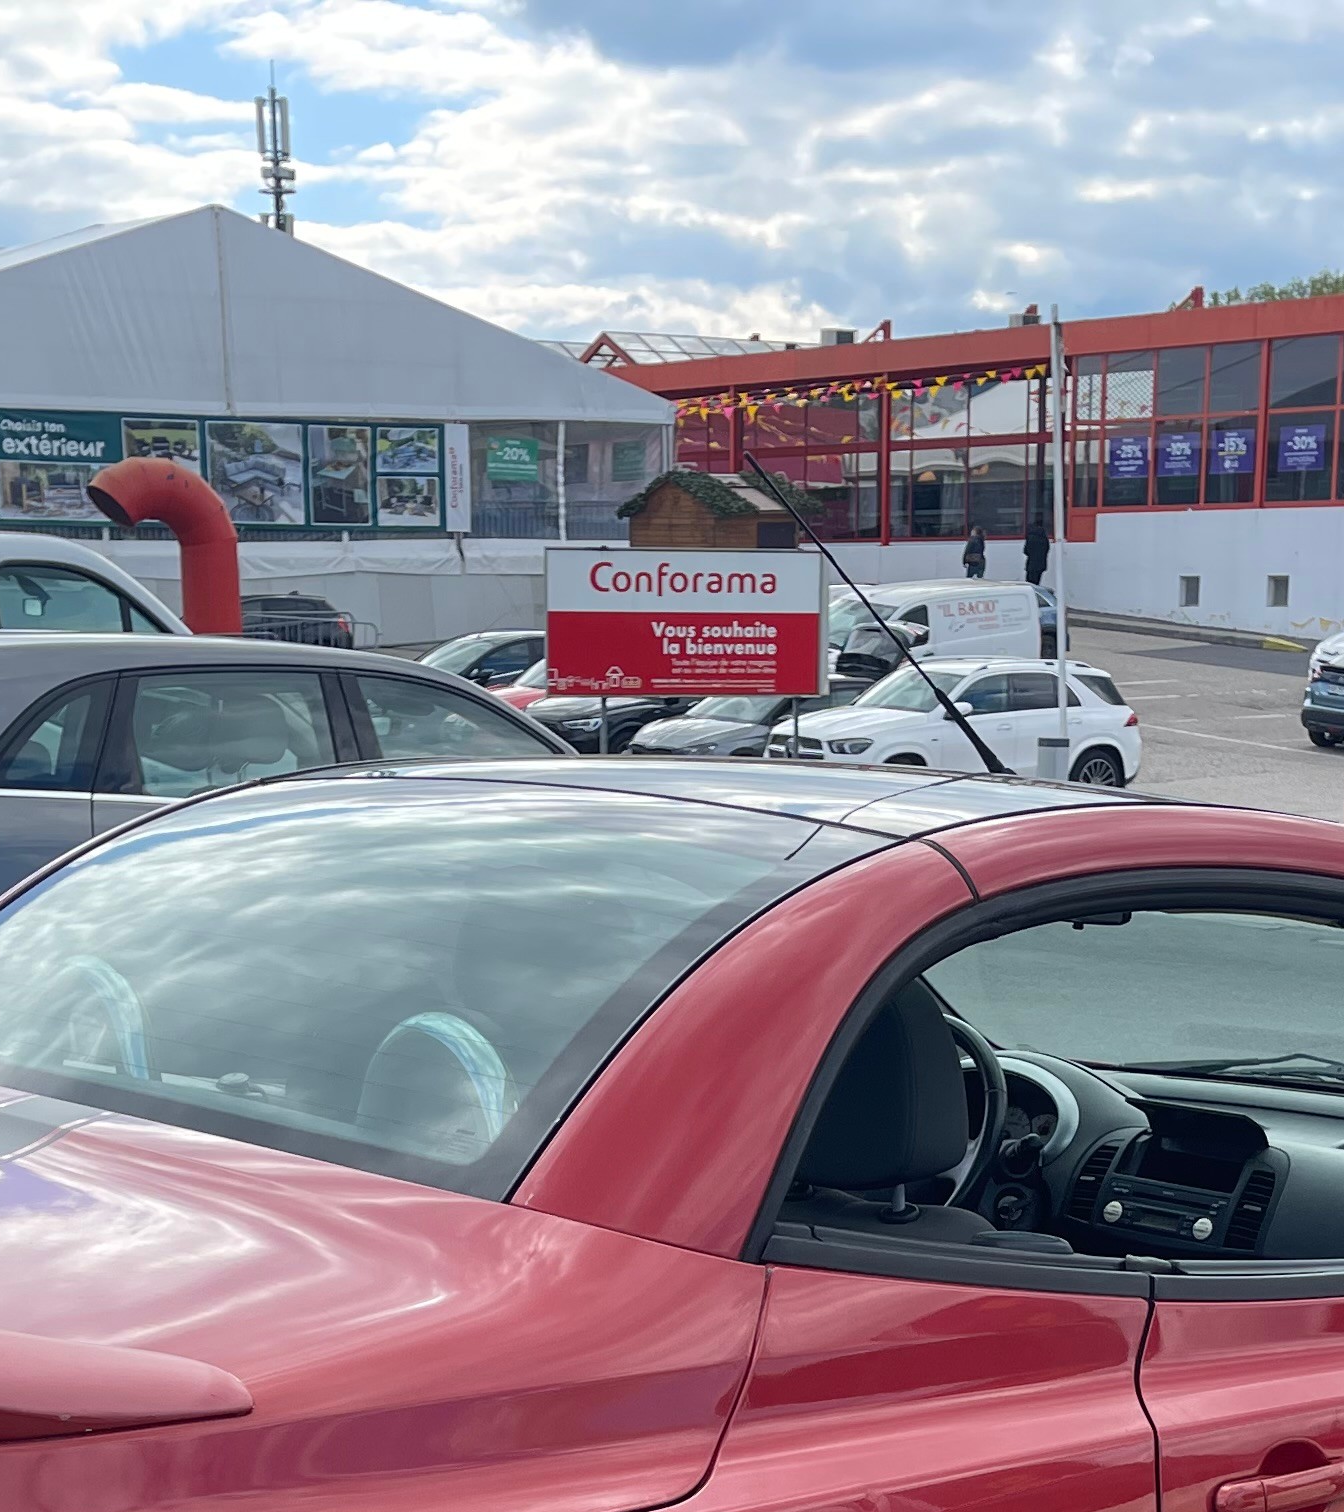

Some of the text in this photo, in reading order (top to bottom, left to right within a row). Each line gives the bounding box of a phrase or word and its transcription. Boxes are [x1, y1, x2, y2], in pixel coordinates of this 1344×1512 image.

[0, 419, 65, 432] Choisis ton
[2, 433, 105, 457] extérieur
[496, 447, 530, 463] -20%
[589, 561, 777, 597] Conforama
[651, 620, 777, 638] Vous souhaite
[662, 638, 777, 655] la bienvenue
